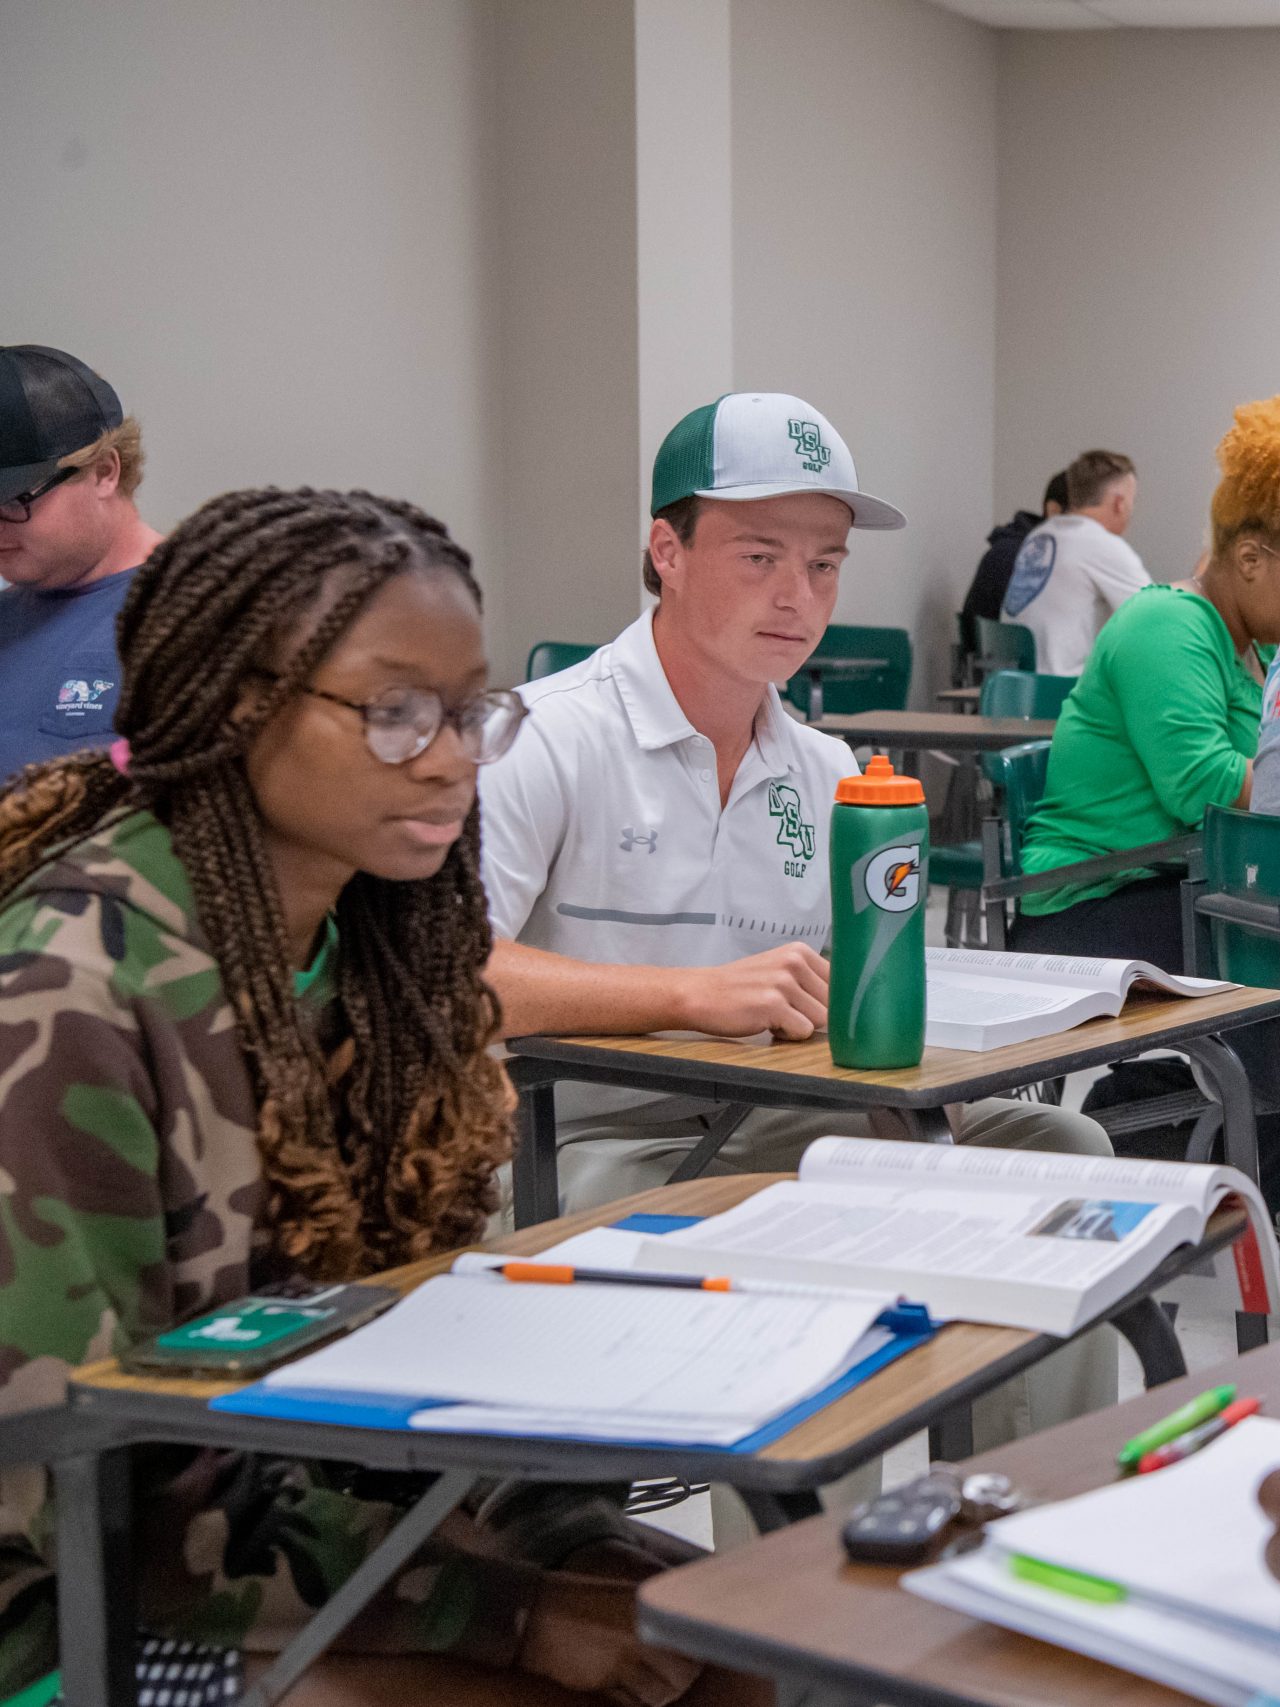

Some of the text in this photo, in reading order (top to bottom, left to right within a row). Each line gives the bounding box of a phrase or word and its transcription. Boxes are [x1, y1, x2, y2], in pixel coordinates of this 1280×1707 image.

[788, 419, 831, 465] DSU
[803, 462, 822, 473] GOLF
[768, 783, 815, 860] DSU
[784, 861, 806, 878] GOLF
[864, 843, 920, 913] G
